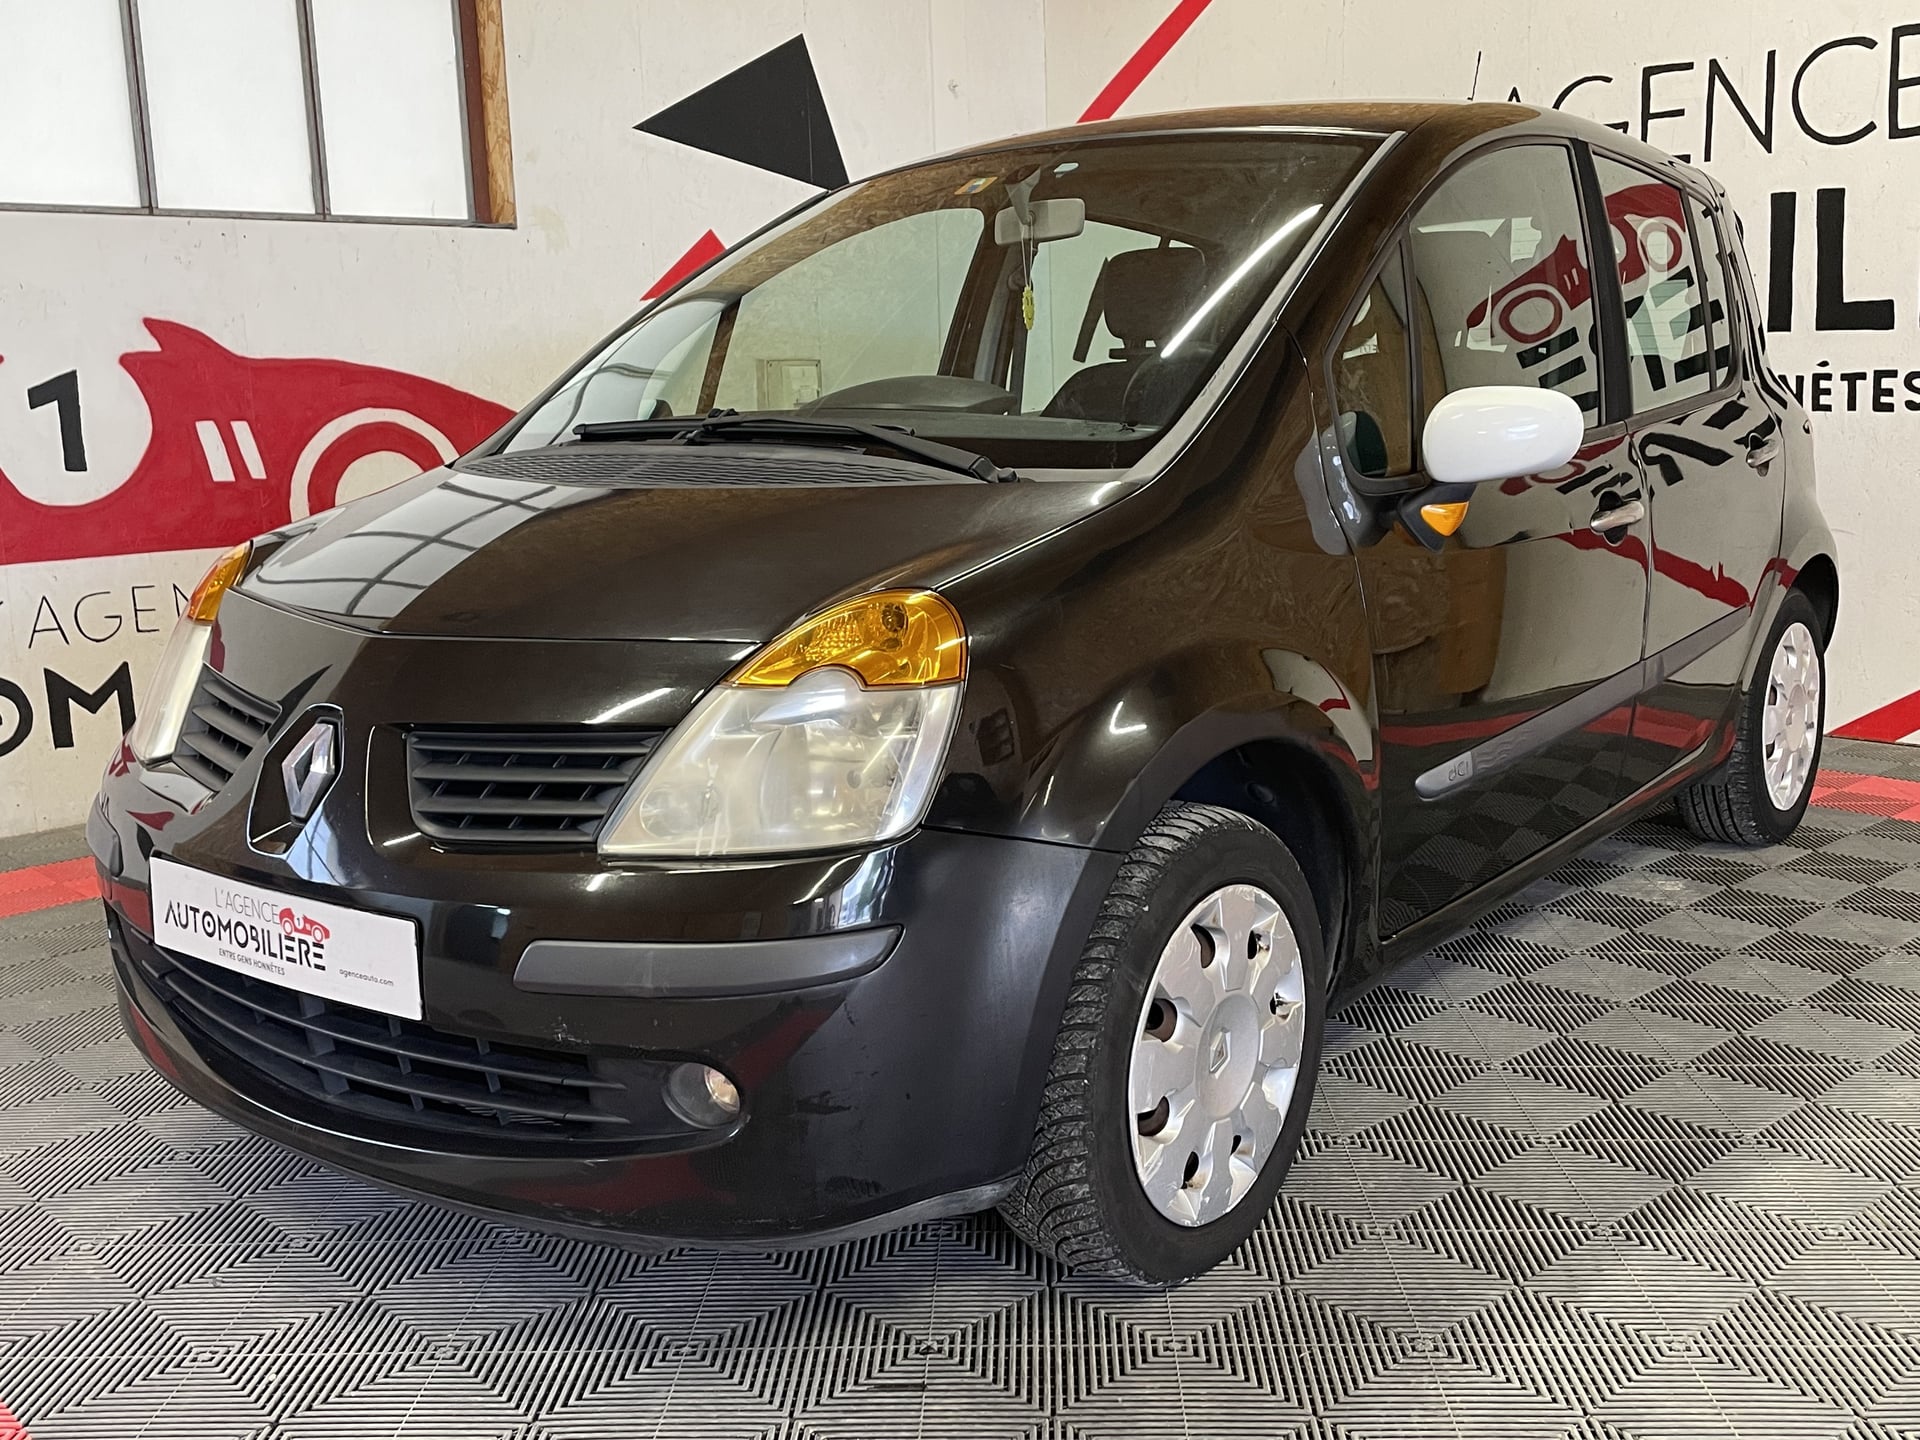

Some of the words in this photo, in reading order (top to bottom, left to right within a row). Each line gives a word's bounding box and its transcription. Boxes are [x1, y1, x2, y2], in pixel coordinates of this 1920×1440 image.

[1508, 23, 1920, 163] ENCE
[1738, 187, 1897, 333] IL
[28, 370, 88, 472] 1
[0, 582, 190, 649] AGE
[214, 887, 281, 925] L'AGENCE
[218, 947, 237, 961] ENTRE
[236, 954, 253, 966] GENS
